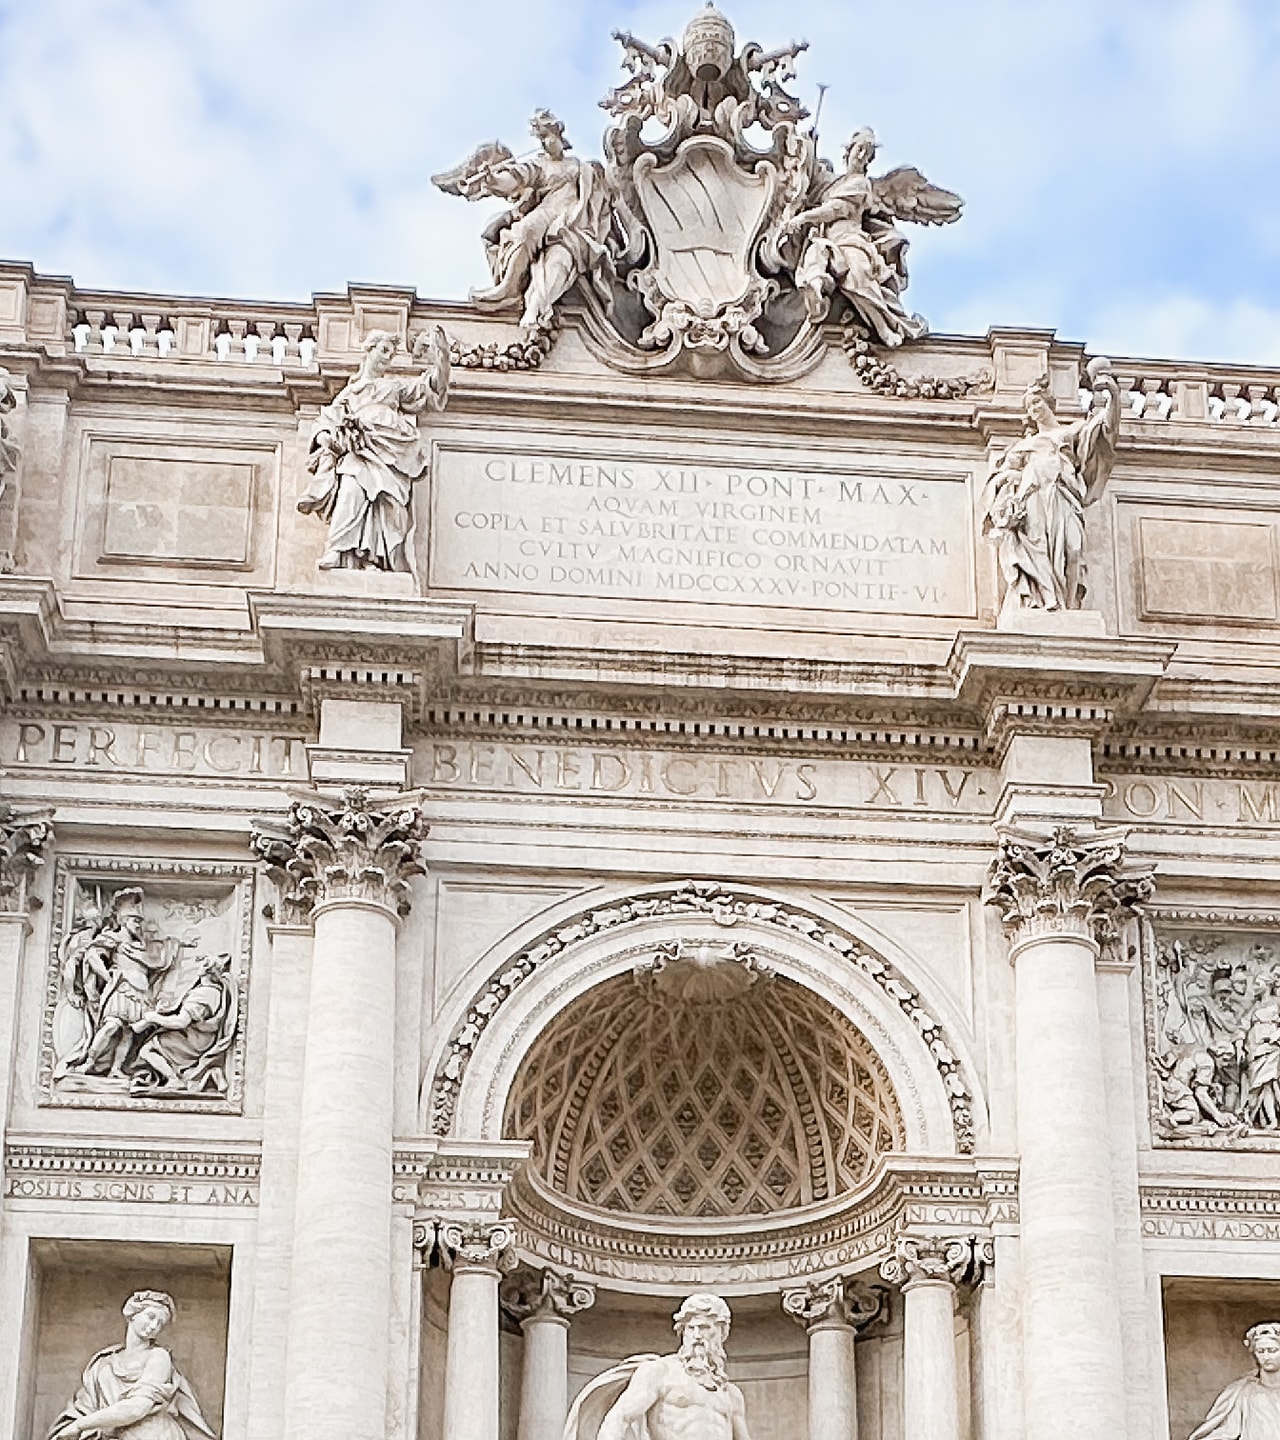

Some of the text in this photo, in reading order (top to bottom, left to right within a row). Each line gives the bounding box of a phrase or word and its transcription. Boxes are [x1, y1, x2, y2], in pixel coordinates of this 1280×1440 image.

[485, 460, 635, 490] CLEMENS
[585, 496, 822, 526] AQVAM VIRGINEM
[454, 512, 949, 556] COPIA ET SALVBRITATE COMMENDATAM
[519, 539, 890, 577] CVLTV MAGNIFICO ORNAVIT
[463, 561, 539, 581] ANNO
[549, 566, 642, 587] DOMINI
[15, 723, 307, 776] PERFECIT
[431, 743, 817, 801] BENEDICTVS
[9, 1179, 82, 1199] POSITIS
[169, 1185, 193, 1203] ET
